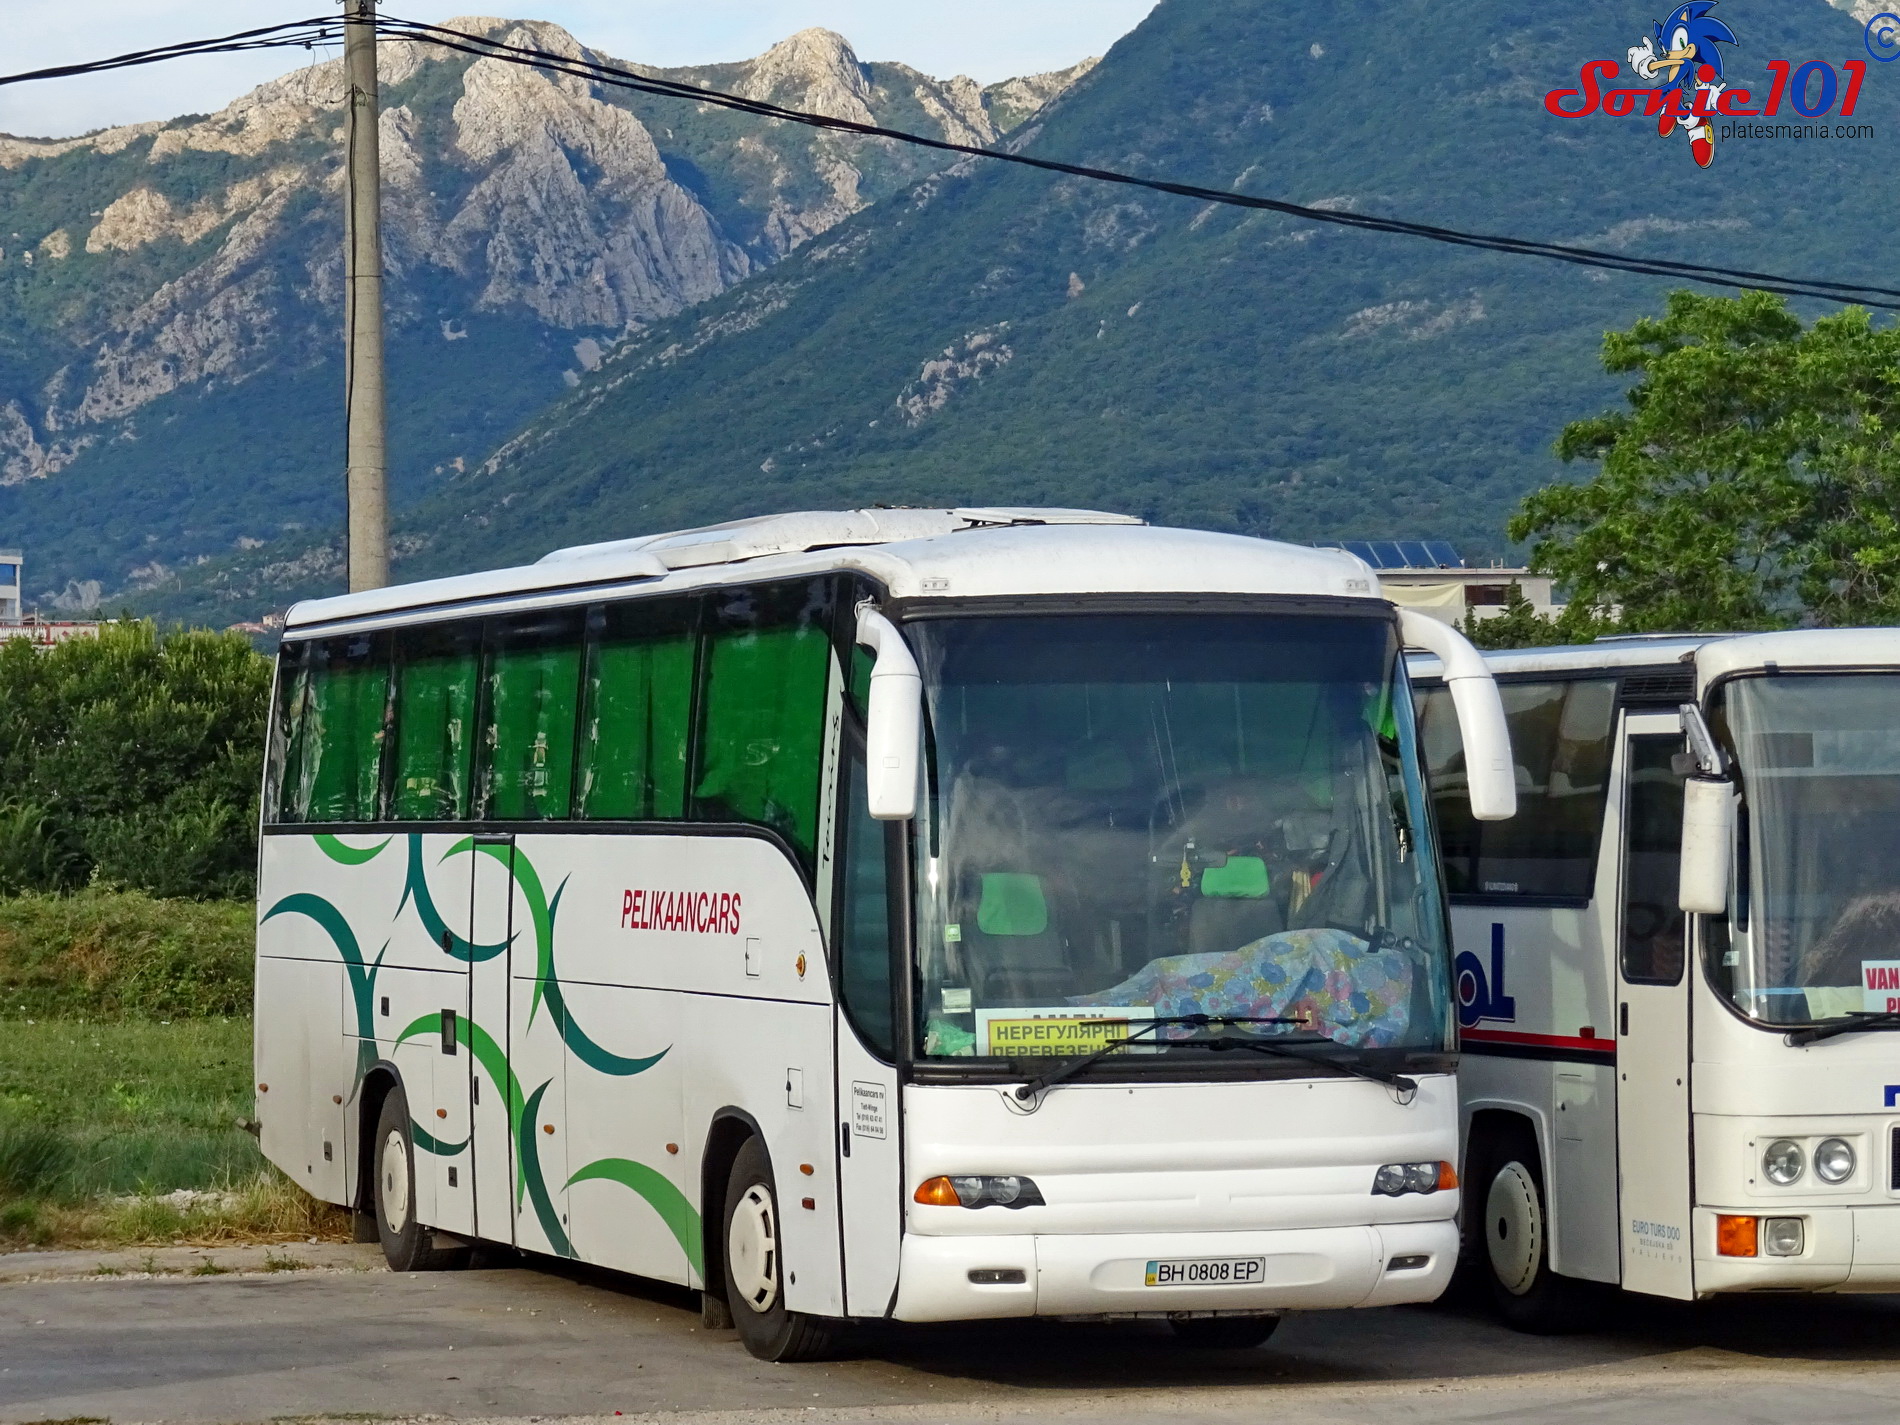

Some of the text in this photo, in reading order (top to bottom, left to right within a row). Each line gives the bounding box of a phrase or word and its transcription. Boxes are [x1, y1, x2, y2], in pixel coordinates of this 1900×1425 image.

[621, 888, 741, 936] PELIKAANCARS
[1632, 1220, 1681, 1241] EURO TURS DOO
[1158, 1264, 1184, 1282] BH
[1188, 1262, 1230, 1281] 0808
[1233, 1261, 1259, 1280] EP
